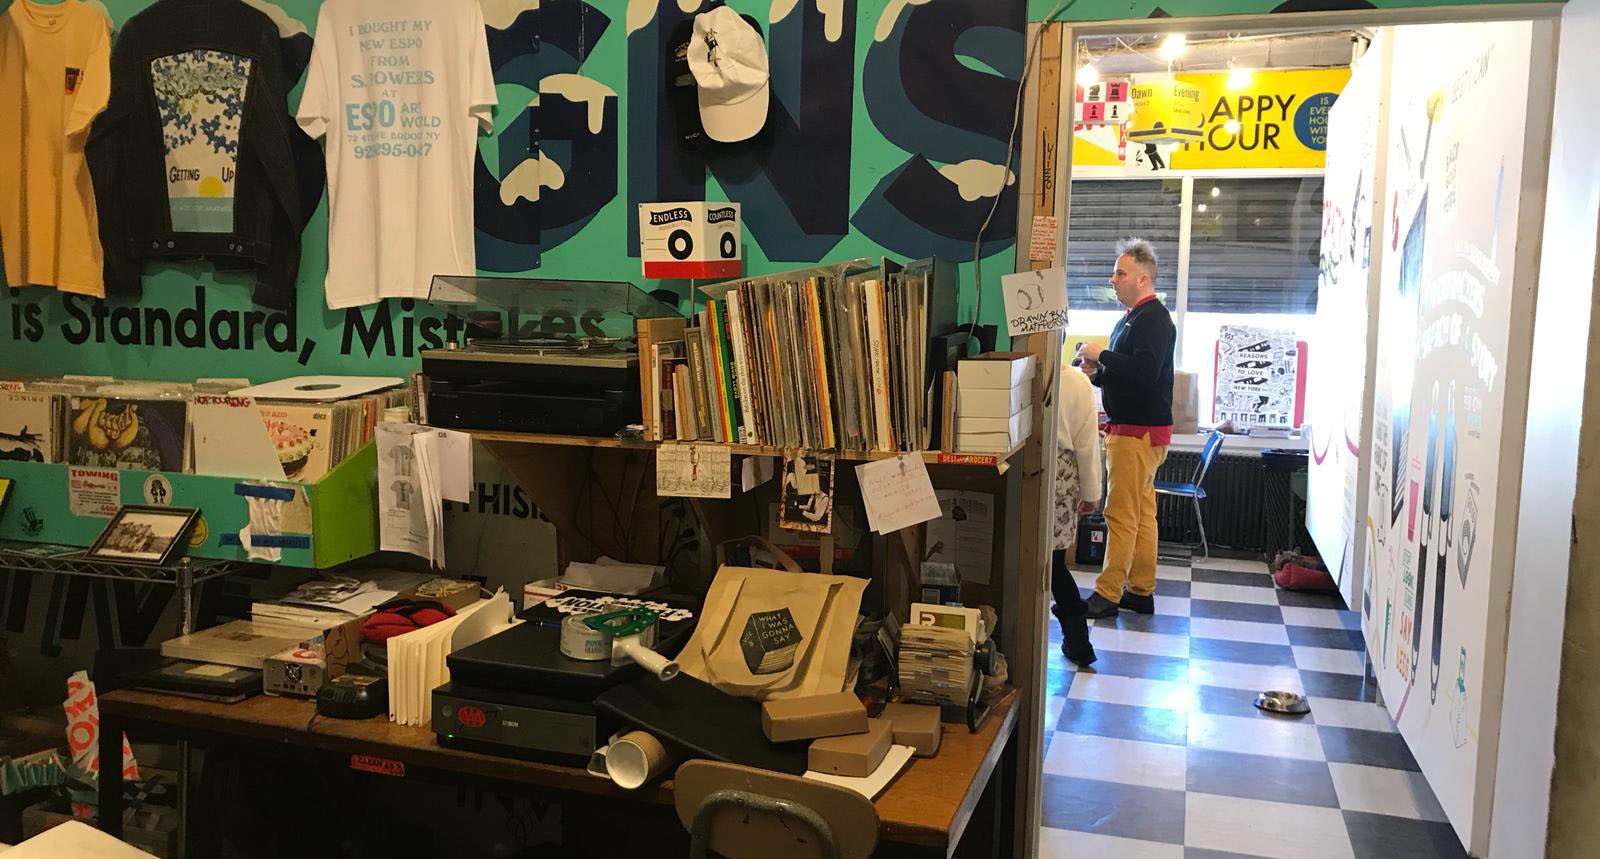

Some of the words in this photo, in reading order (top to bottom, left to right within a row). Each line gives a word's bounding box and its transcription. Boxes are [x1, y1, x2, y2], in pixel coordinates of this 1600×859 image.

[358, 20, 408, 35] BOUGHT
[413, 20, 433, 31] MY
[390, 38, 423, 49] ESPO
[370, 55, 410, 66] FROM
[382, 89, 398, 98] AT
[1131, 88, 1153, 99] Dawn
[1174, 85, 1200, 102] Evening
[1320, 97, 1329, 105] IS
[1207, 94, 1296, 123] APPY
[653, 210, 688, 223] ENDLESS
[709, 210, 734, 221] COUNTLESS
[1010, 310, 1049, 328] DRAWN
[11, 287, 44, 342] is
[60, 286, 317, 367] Standard,
[71, 469, 118, 481] TOWING
[758, 613, 781, 622] WHAT
[768, 617, 788, 629] WAS
[762, 623, 794, 639] GONNA
[773, 632, 790, 644] SAY
